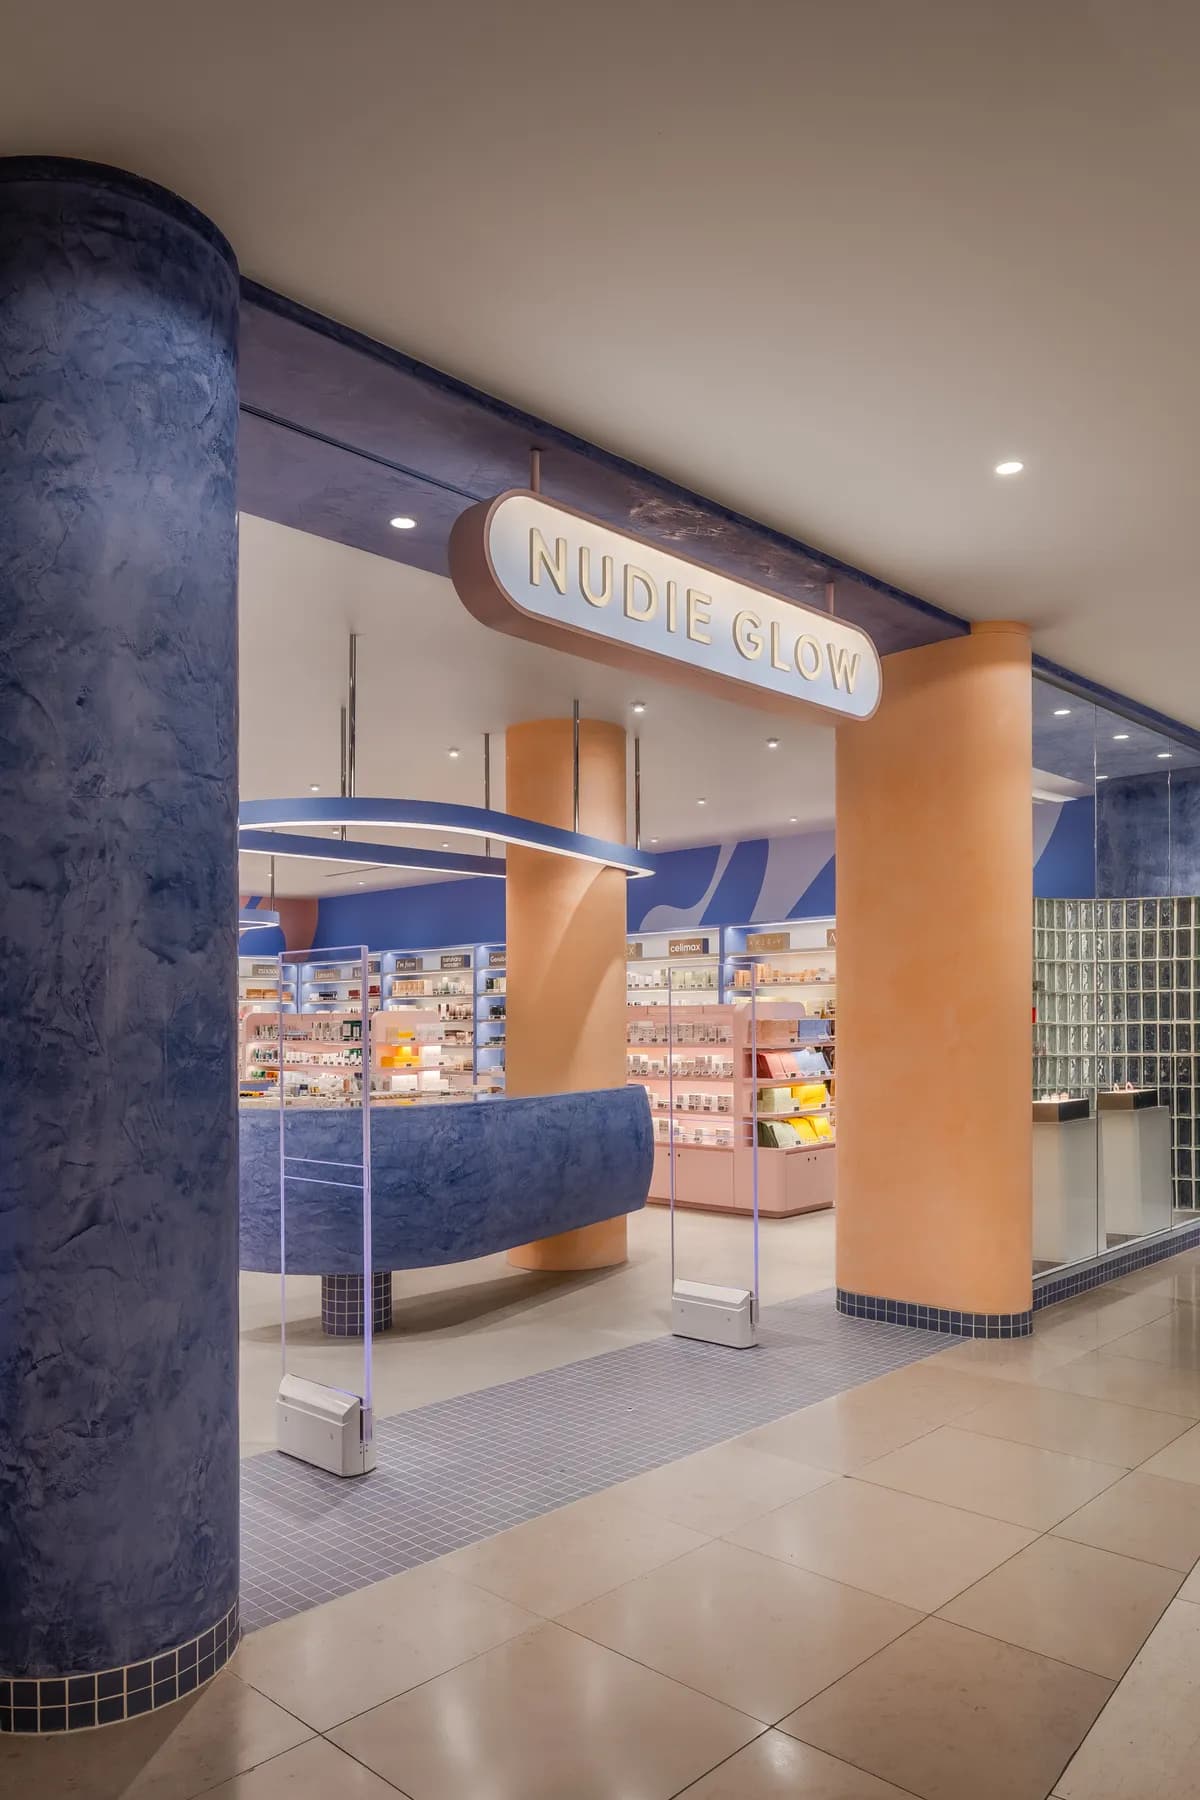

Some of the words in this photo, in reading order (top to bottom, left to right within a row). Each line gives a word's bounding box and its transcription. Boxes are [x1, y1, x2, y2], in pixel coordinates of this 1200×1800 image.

[529, 527, 713, 646] NUDIE
[732, 610, 861, 695] GLOW
[670, 943, 701, 953] celimax
